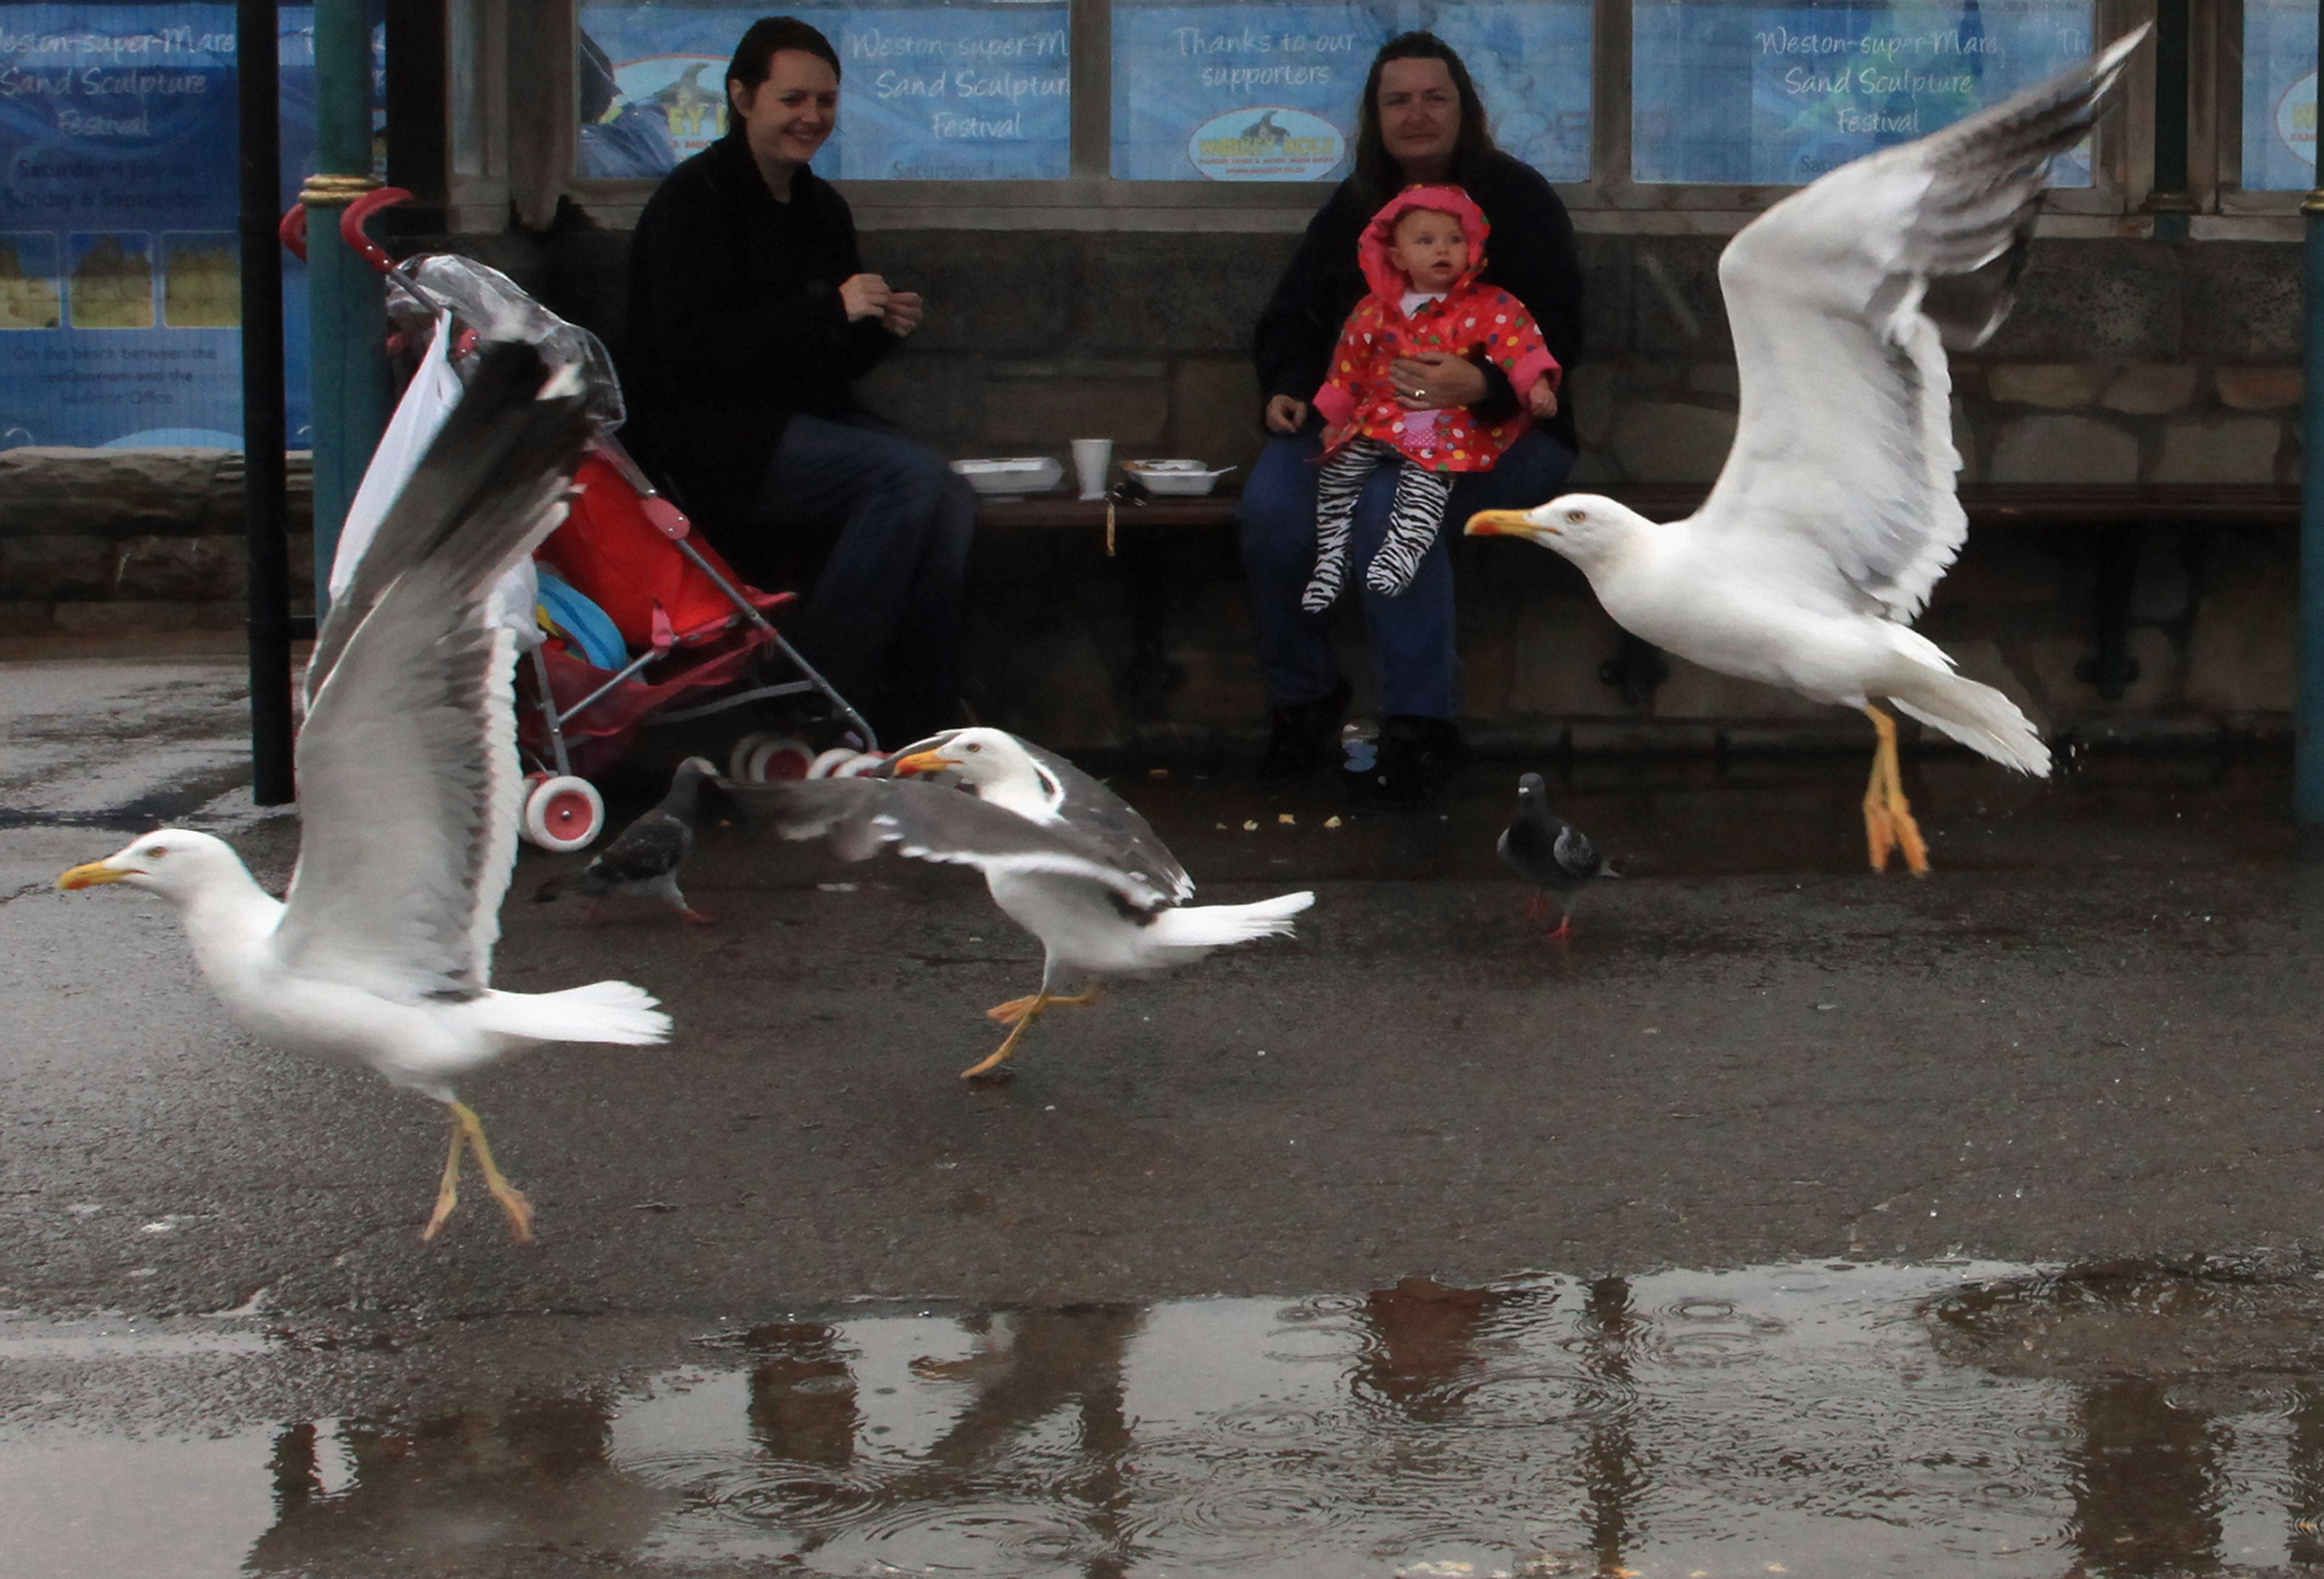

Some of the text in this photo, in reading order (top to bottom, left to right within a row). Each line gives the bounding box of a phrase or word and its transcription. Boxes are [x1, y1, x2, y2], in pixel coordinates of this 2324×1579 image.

[0, 24, 236, 63] eston-super-Mare
[1174, 26, 1356, 55] Thanks to our
[0, 67, 207, 104] Sand Sculpture
[875, 69, 946, 98] Sand
[1202, 65, 1332, 95] supporters
[1785, 67, 1974, 103] Sand Sculpture
[58, 109, 151, 138] Festival
[932, 110, 1022, 139] Festival
[1836, 107, 1921, 133] Festival
